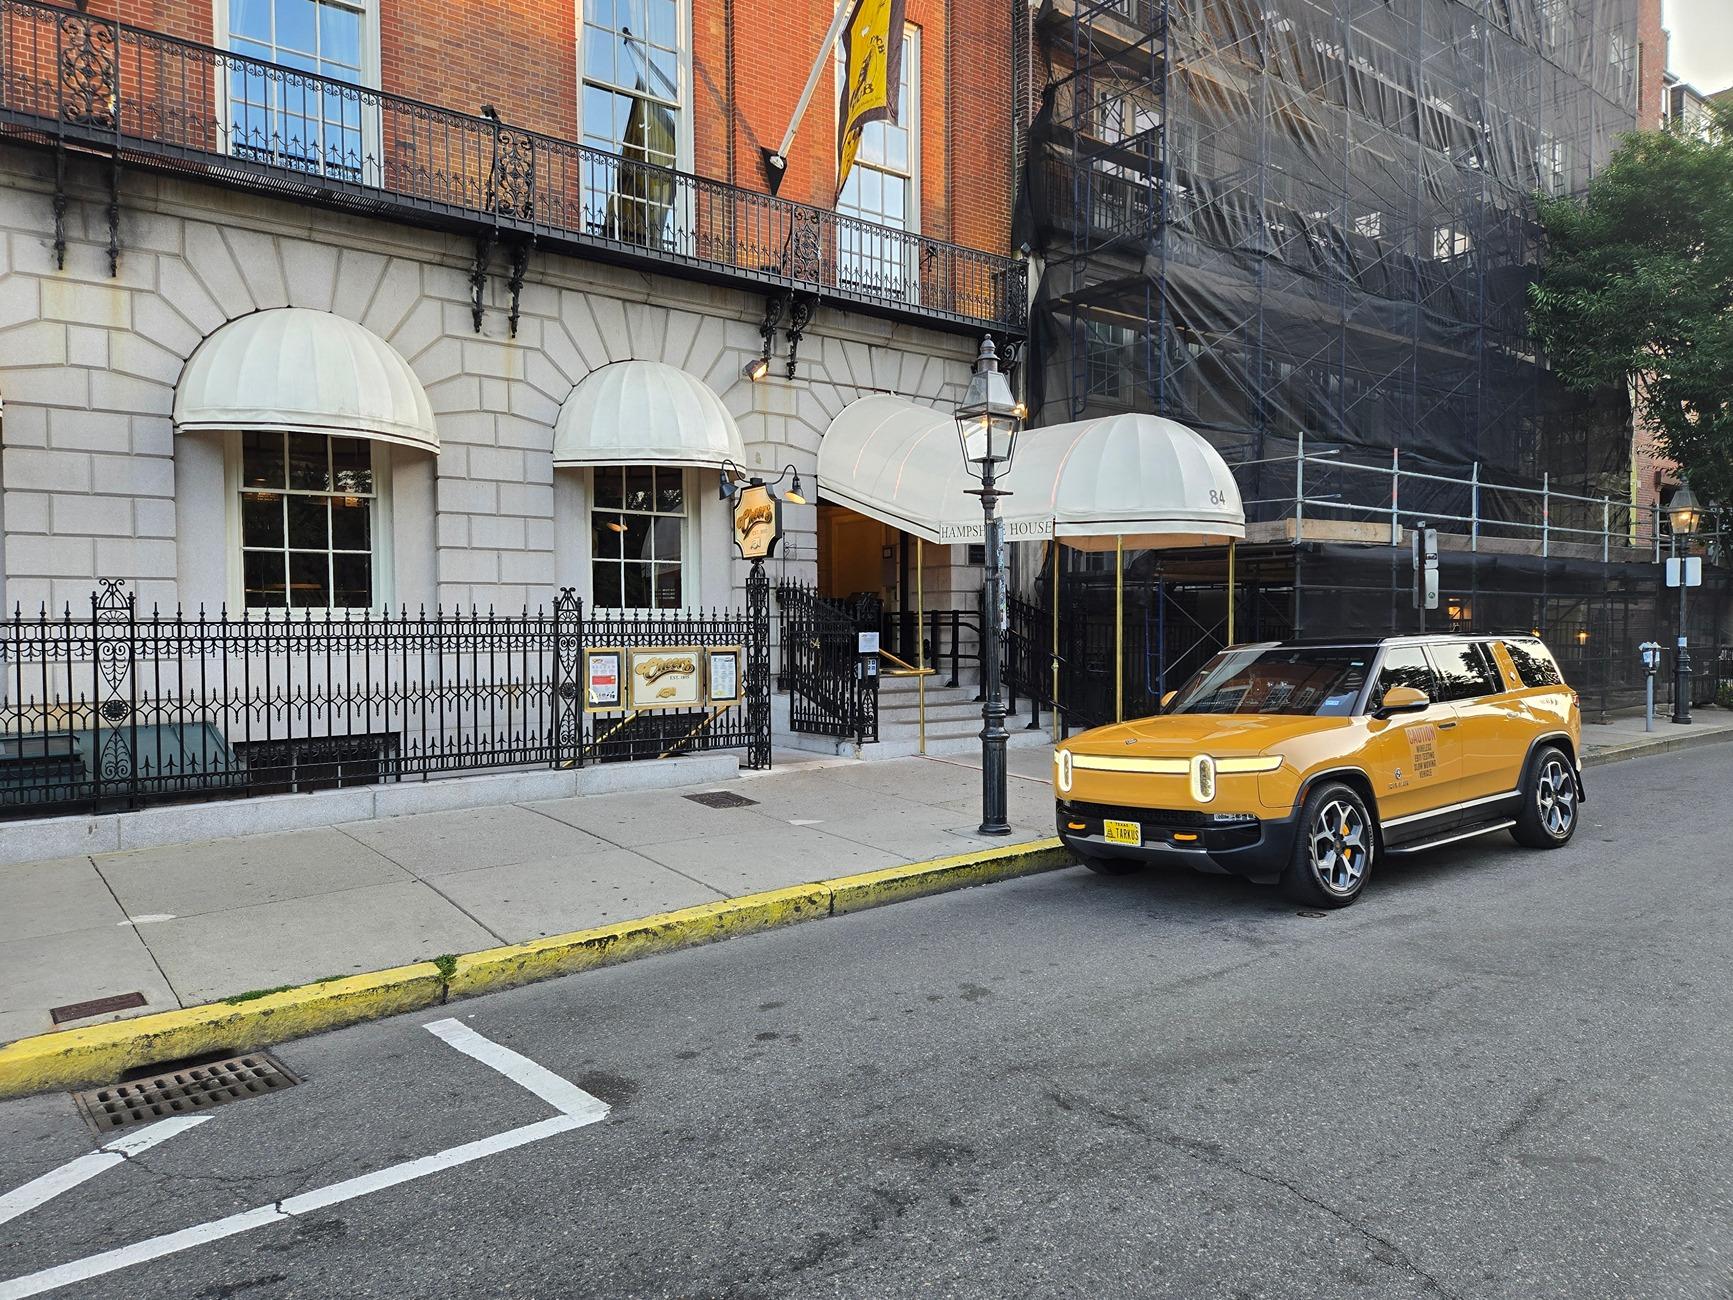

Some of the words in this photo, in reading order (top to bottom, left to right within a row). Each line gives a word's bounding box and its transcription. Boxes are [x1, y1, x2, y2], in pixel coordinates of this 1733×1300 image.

[1209, 489, 1226, 506] 84
[941, 523, 1006, 539] HAMPSH
[1010, 520, 1053, 536] HOUSE
[635, 657, 695, 687] Cheers
[1407, 726, 1436, 745] CAUTION
[1116, 827, 1139, 841] TARKUS
